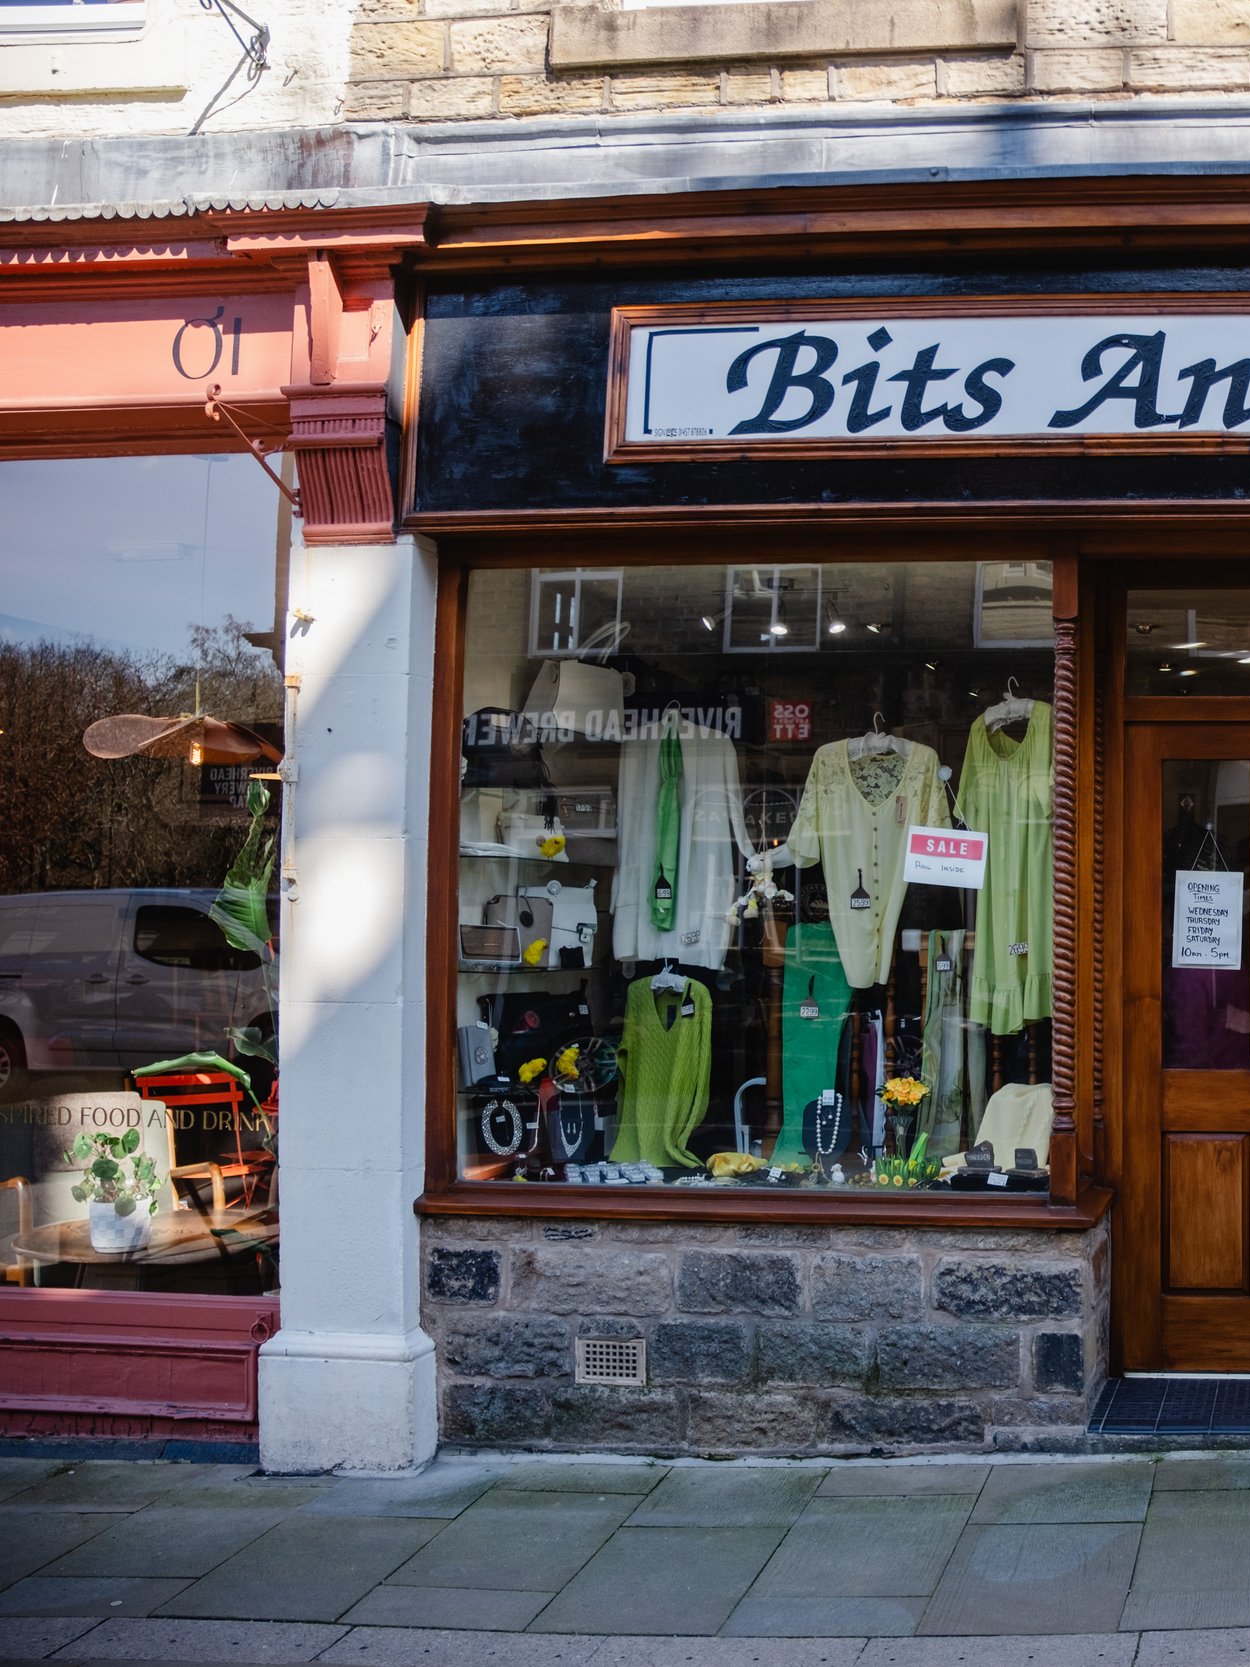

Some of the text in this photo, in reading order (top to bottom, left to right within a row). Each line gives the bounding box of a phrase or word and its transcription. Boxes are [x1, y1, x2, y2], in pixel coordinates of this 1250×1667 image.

[726, 326, 1016, 436] Bits
[926, 838, 969, 855] SALE
[1187, 882, 1221, 893] OPENING
[1187, 906, 1229, 918] WEDNESDAY
[1186, 916, 1221, 926] THURSDAY
[1187, 926, 1214, 936] FRIDAY
[1186, 935, 1221, 946] SATURDAY
[80, 1107, 141, 1128] FOOD
[147, 1109, 195, 1130] AND
